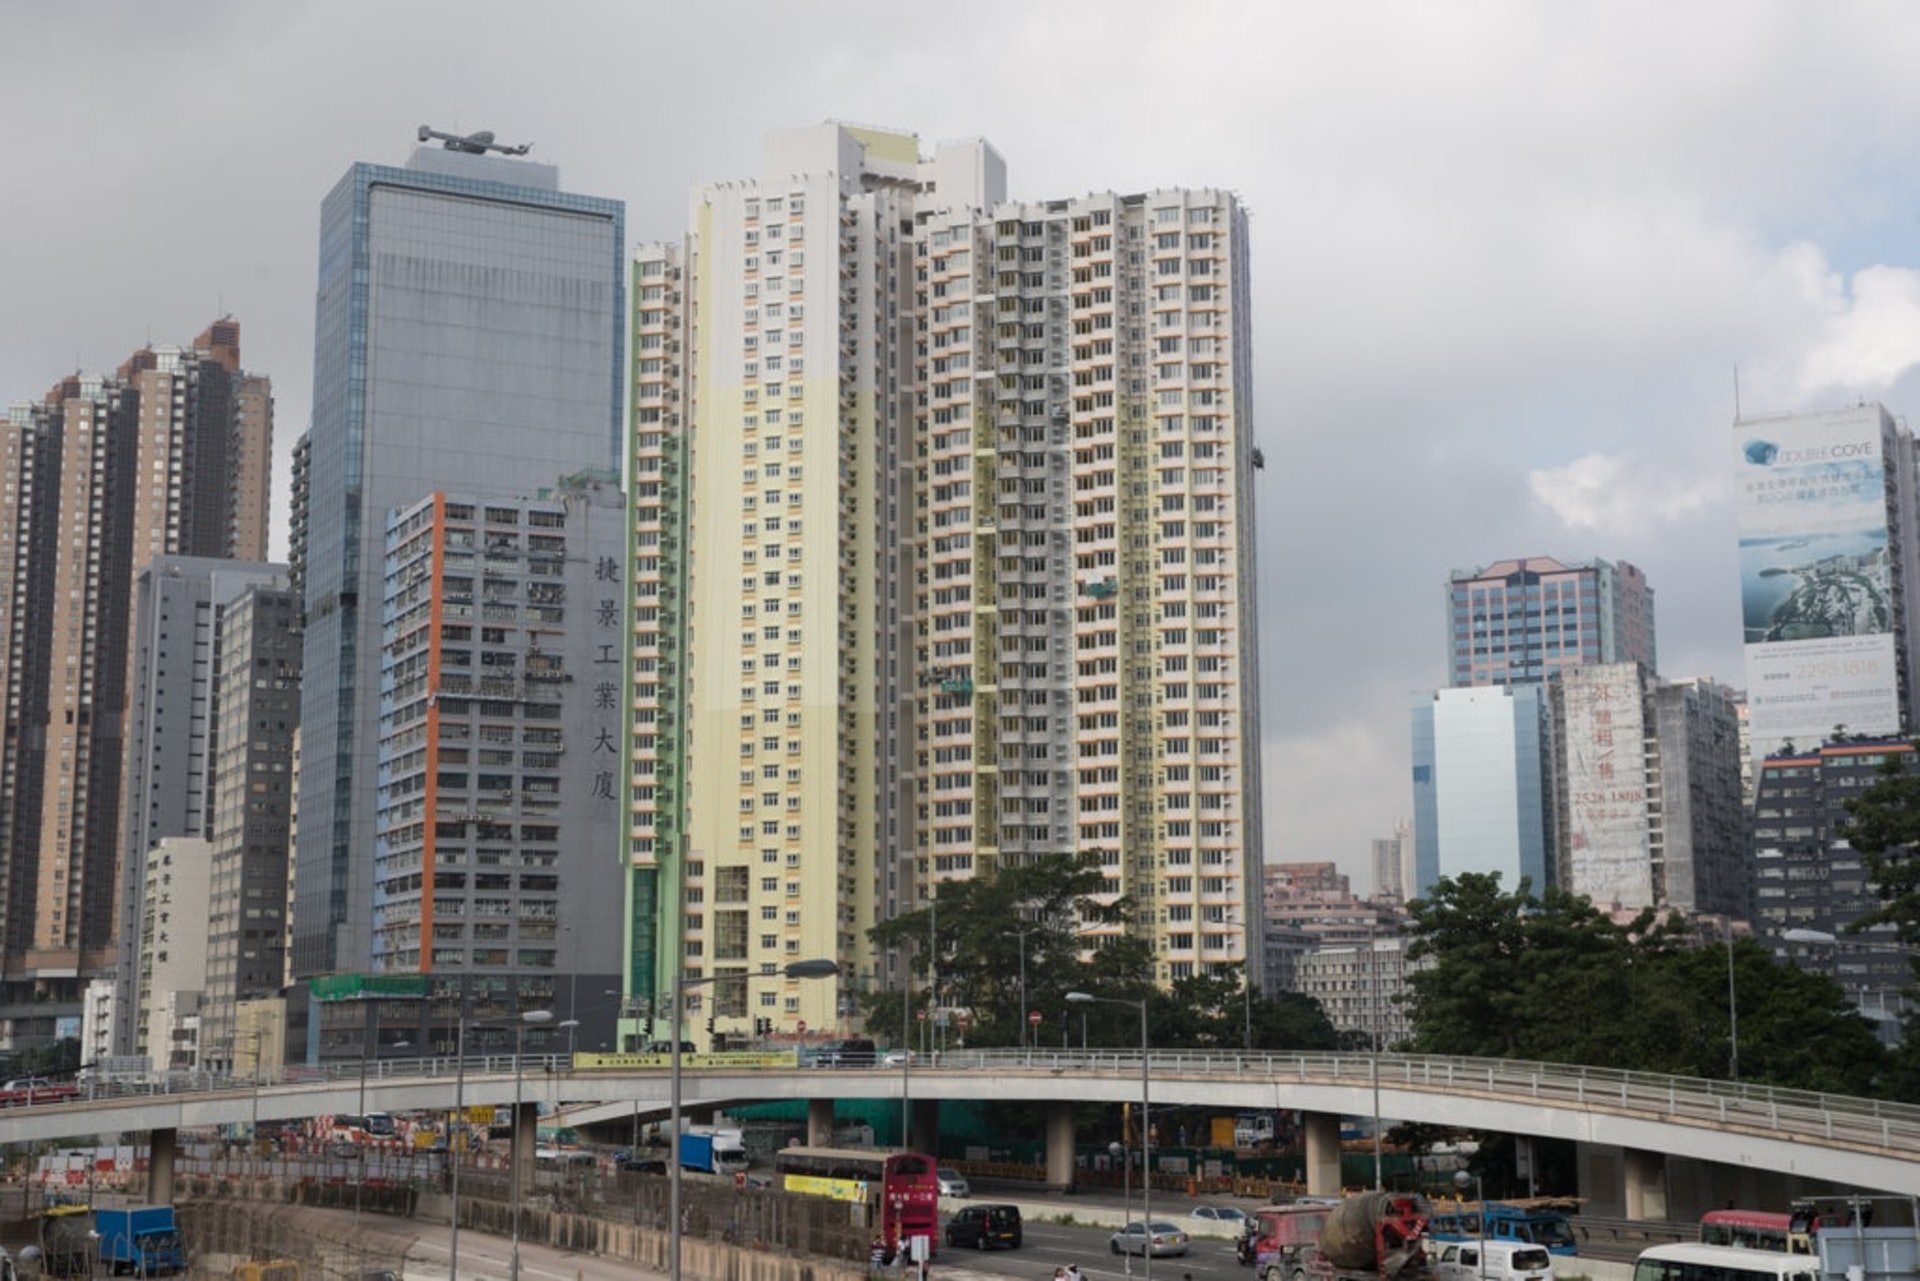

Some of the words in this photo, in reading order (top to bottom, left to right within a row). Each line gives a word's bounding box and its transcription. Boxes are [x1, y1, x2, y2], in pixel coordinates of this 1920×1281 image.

[1831, 441, 1872, 458] COVE
[592, 556, 621, 801] 捷景工業大廈
